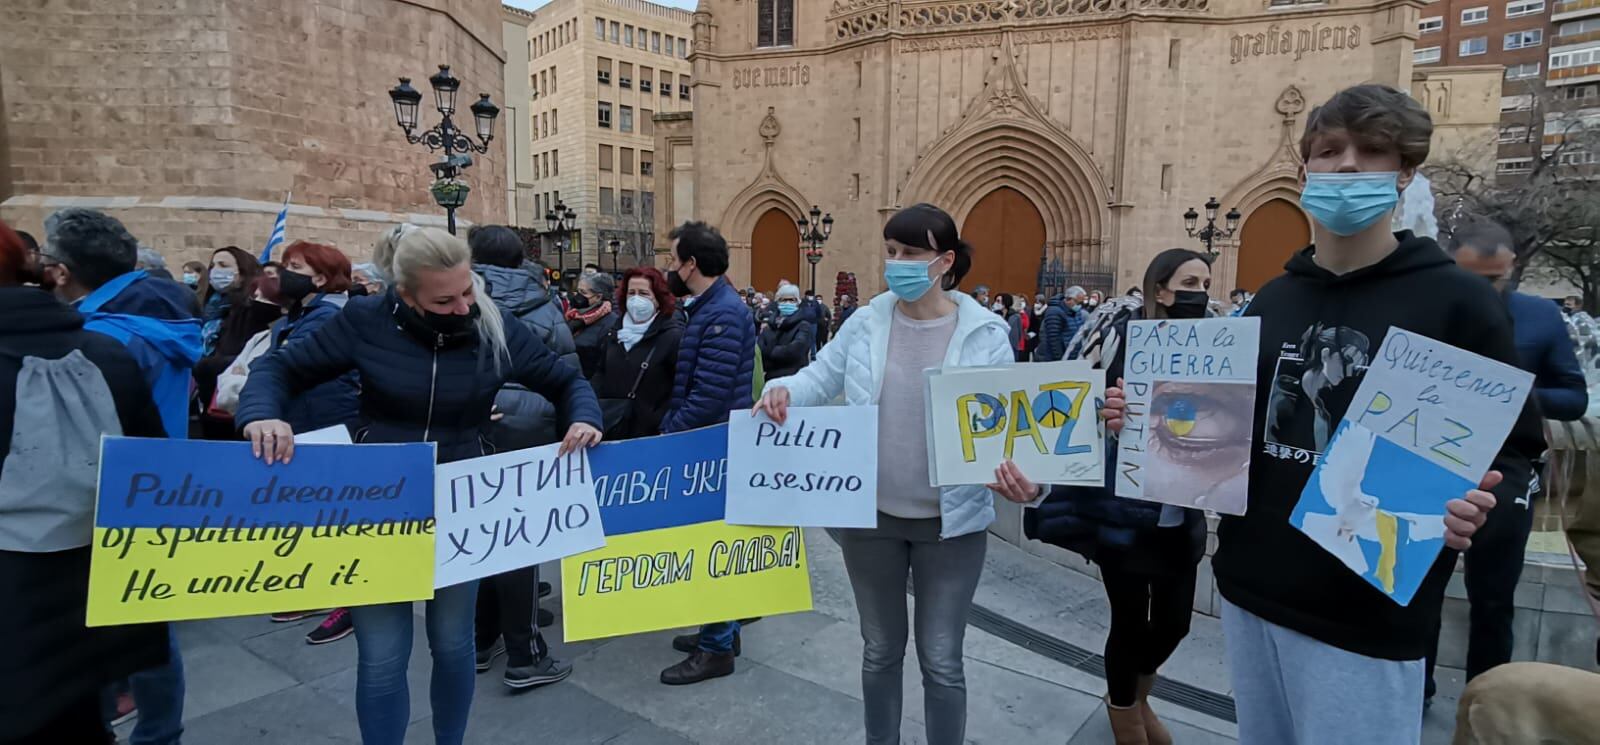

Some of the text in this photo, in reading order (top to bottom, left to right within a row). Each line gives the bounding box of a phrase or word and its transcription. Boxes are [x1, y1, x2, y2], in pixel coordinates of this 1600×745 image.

[1294, 22, 1361, 62] plena
[764, 61, 810, 87] maria
[1128, 324, 1236, 348] PARA la
[1130, 350, 1233, 376] GUERRA
[1384, 332, 1517, 403] Quieremos
[1416, 384, 1441, 405] la
[755, 419, 842, 449] Putin
[956, 381, 1092, 462] PAZ
[1357, 391, 1473, 467] PAZ
[125, 472, 406, 509] Putin dreamed
[450, 448, 585, 513] ПУТИН
[593, 465, 672, 507] ЛАВА
[749, 470, 862, 492] asesino
[101, 508, 436, 560] of splitting Ukraine
[121, 558, 369, 603] He united it.
[578, 525, 801, 596] ГЕРОЯМ СЛАВА!
